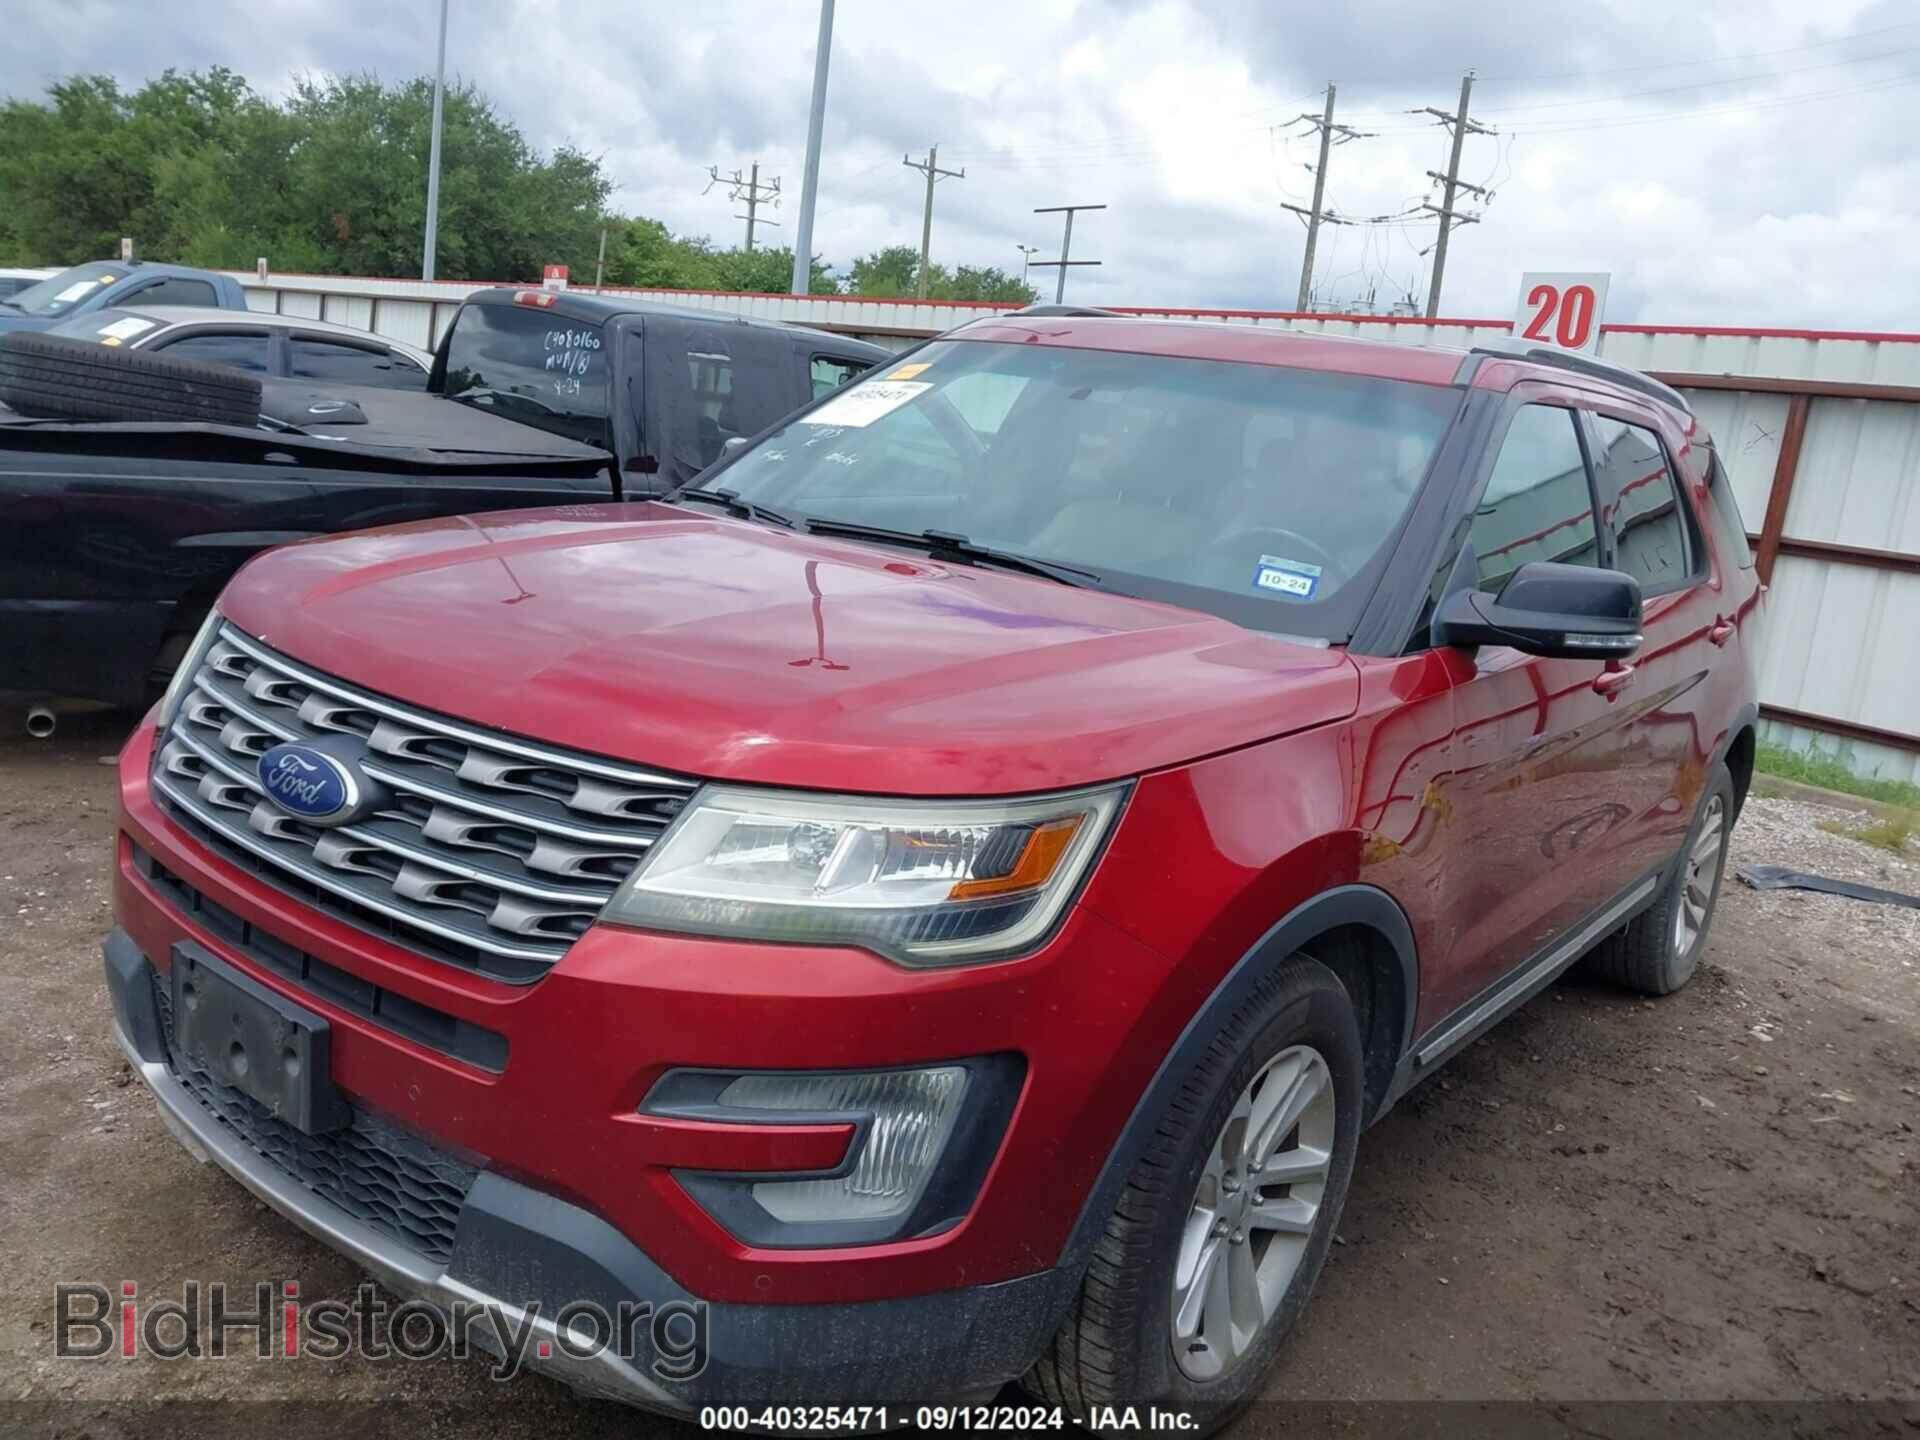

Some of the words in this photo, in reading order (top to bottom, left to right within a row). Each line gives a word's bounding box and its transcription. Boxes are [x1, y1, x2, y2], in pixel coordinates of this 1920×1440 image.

[1522, 284, 1595, 348] 20
[1264, 574, 1308, 590] 10-24
[268, 753, 328, 805] Ford
